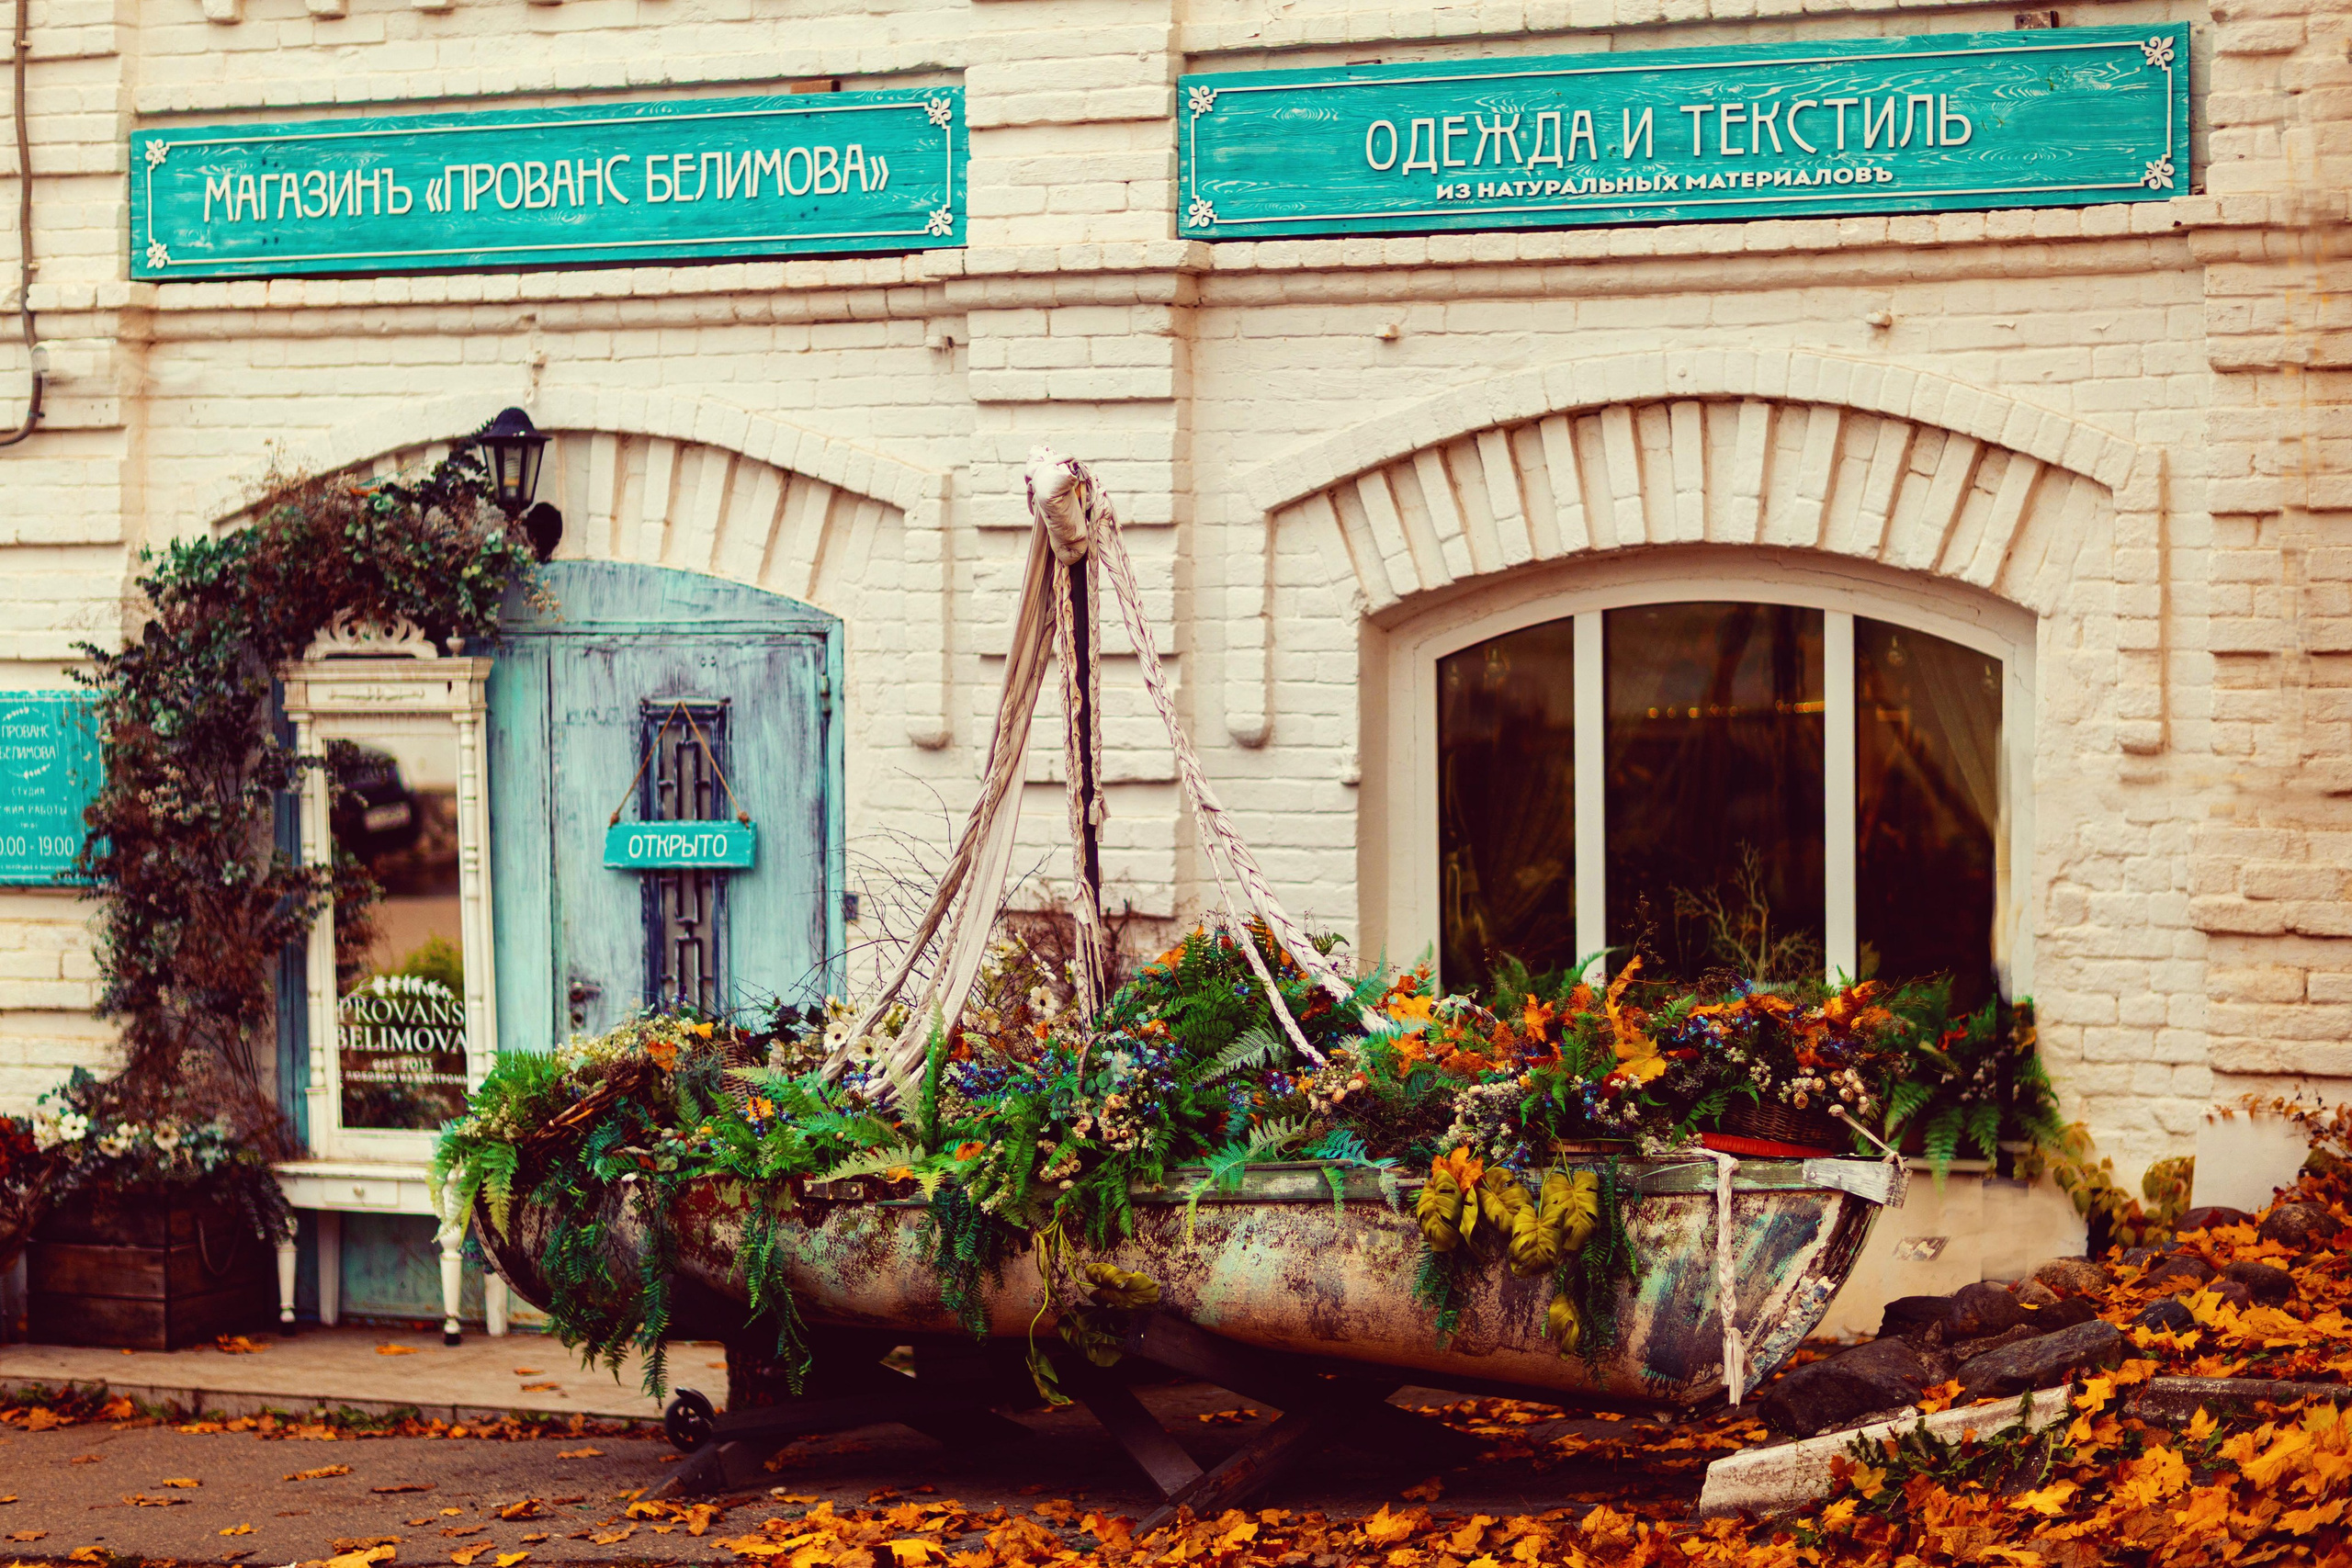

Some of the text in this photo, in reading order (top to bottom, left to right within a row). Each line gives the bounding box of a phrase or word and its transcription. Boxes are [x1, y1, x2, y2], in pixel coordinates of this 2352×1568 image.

[1364, 93, 1973, 175] ОДЕЖДА И ТЕКСТИЛЬ
[203, 143, 888, 222] МАГАЗИНЪ «ПРОВАНС БЕЛИМОВА»
[1435, 166, 1894, 201] ИЗ НАТУРАЛЬНЫХ МАТЕРИАЛОВЪ
[2, 724, 50, 739] ПРОВАНС
[38, 836, 74, 856] 19.00
[628, 834, 728, 858] ОТКРЫТО
[337, 997, 465, 1027] PROVANS
[336, 1025, 468, 1055] BELIMOVA
[399, 1056, 433, 1072] 2013
